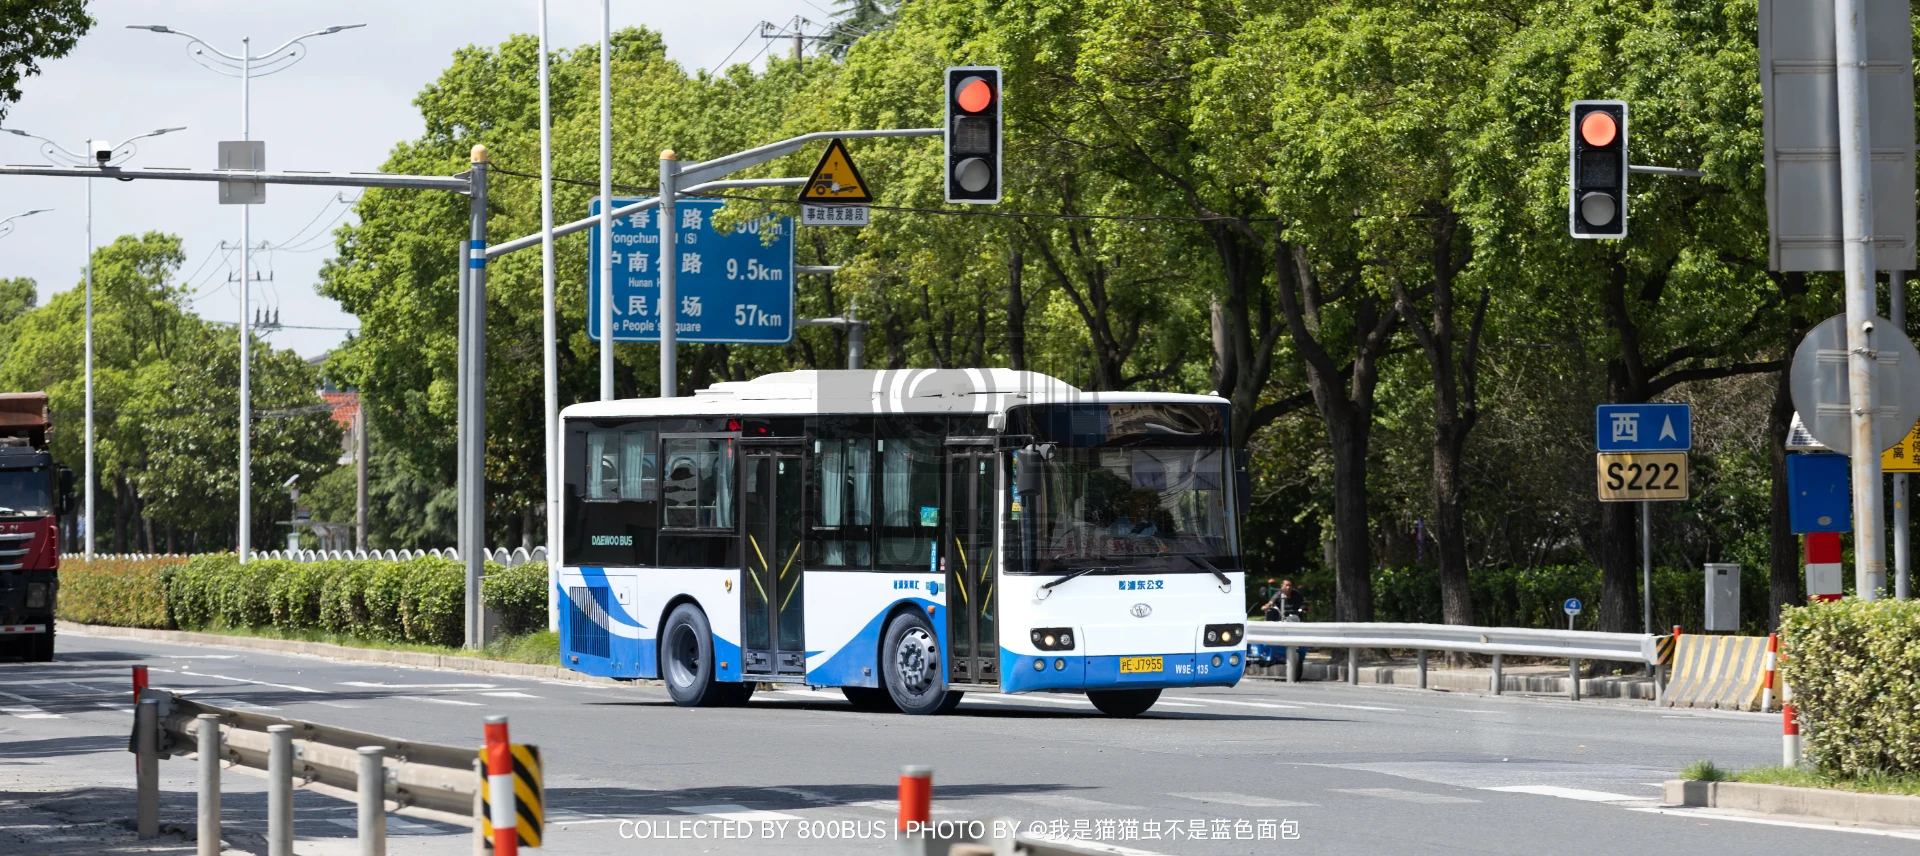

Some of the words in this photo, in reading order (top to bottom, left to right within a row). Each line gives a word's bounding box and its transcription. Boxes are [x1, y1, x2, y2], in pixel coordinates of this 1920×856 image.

[612, 207, 703, 230] 春路
[806, 207, 864, 221] 事故易发路段
[611, 231, 659, 247] ongchun
[684, 232, 697, 245] (S)
[611, 250, 703, 275] 南路
[726, 258, 783, 281] 9.5km
[628, 276, 653, 288] Hunan
[611, 294, 702, 317] 民场
[734, 303, 782, 327] 57km
[675, 321, 702, 335] quare
[1609, 412, 1640, 443] 西
[1606, 462, 1680, 491] S222
[591, 535, 620, 546] DAEWOO
[620, 535, 633, 546] BUS
